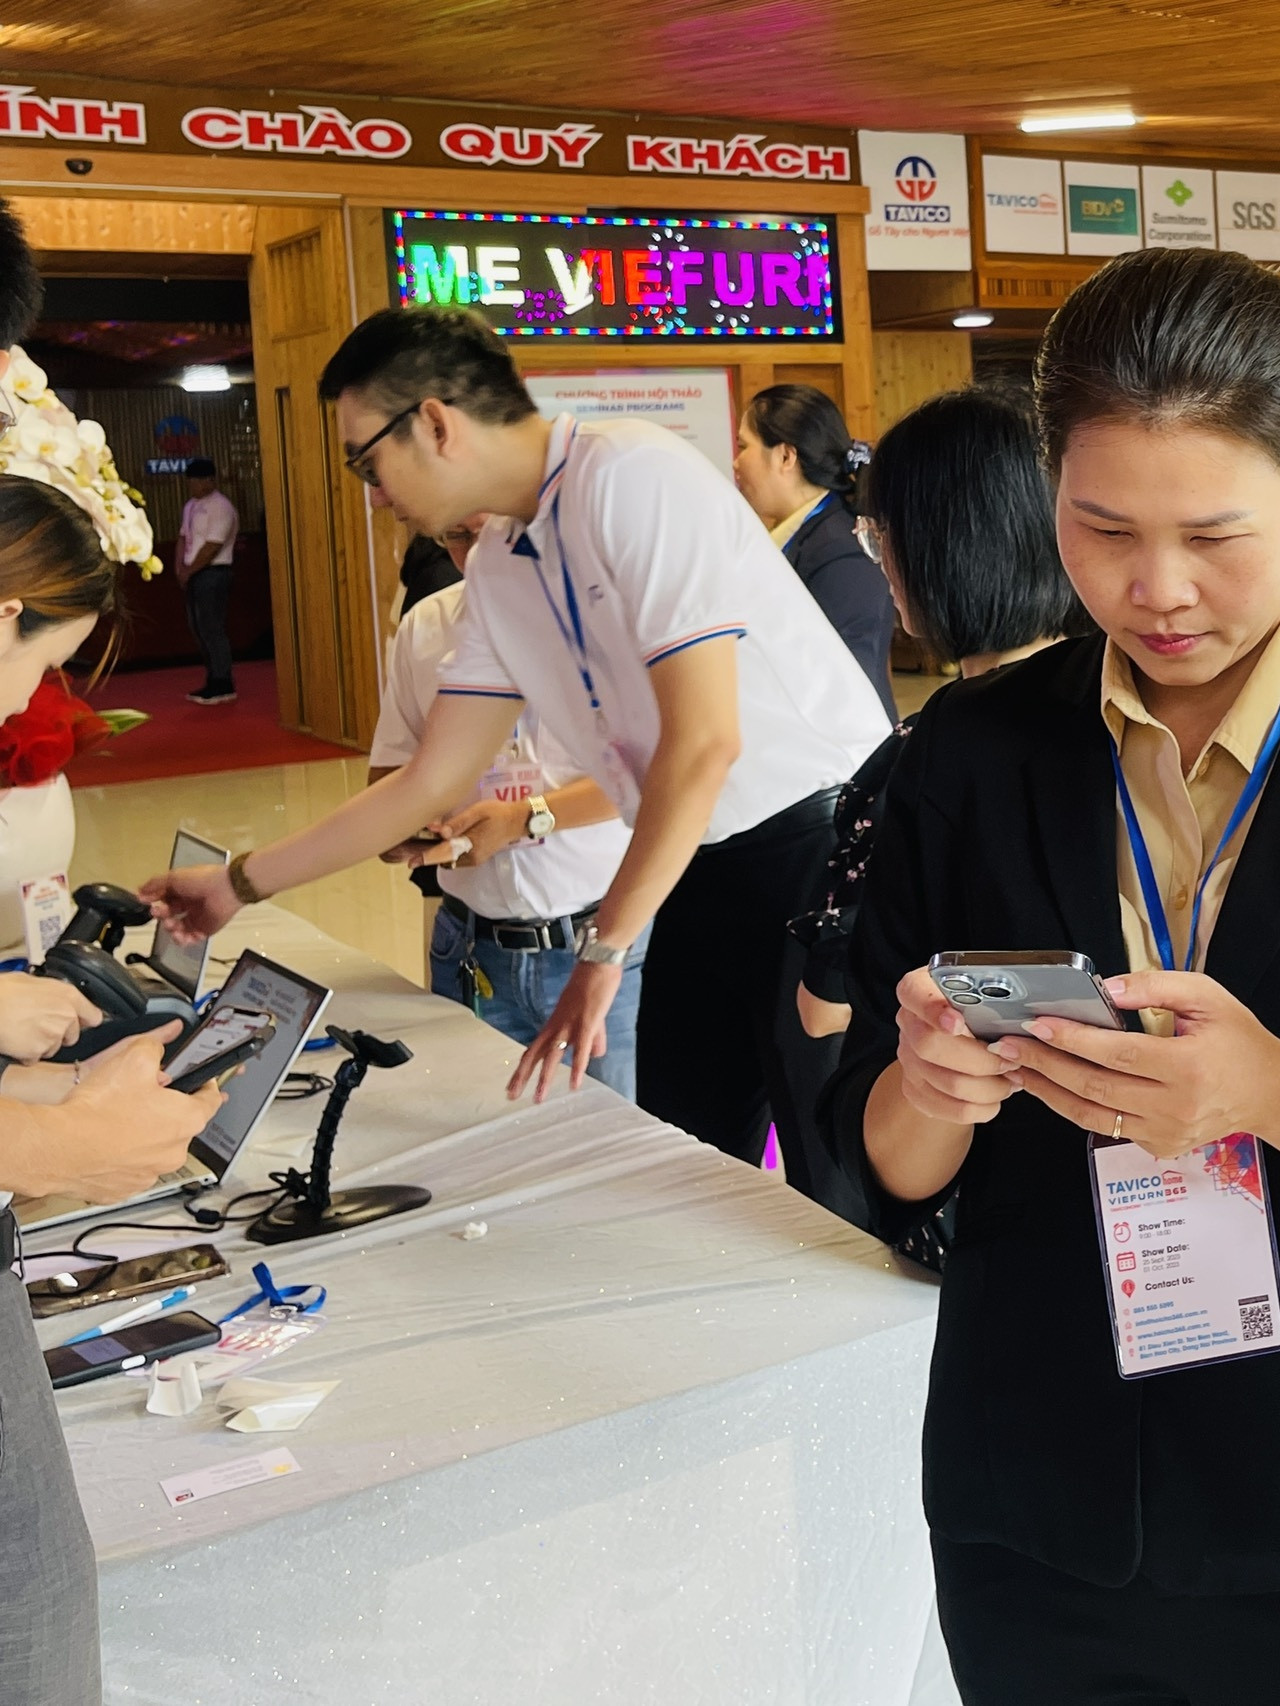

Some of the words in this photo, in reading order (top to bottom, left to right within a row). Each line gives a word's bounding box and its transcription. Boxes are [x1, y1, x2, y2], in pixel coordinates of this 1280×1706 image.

[182, 105, 412, 159] CHÀO
[440, 123, 602, 167] QUÝ
[627, 134, 851, 180] KHÁCH
[987, 193, 1038, 208] TAVICO
[886, 206, 949, 222] TAVICO
[1152, 212, 1208, 226] Sumitomo
[1232, 201, 1276, 230] SGS
[1149, 228, 1212, 242] Corporation
[411, 244, 525, 305] ME
[627, 402, 685, 411] PROGRAMS
[495, 785, 532, 802] VIP
[1106, 1175, 1161, 1195] TAVICO
[1108, 1186, 1188, 1206] VIEFURN365
[1138, 1223, 1161, 1232] Show
[1163, 1218, 1186, 1228] Time:
[1141, 1249, 1164, 1258] Show
[1166, 1243, 1191, 1253] Date:
[1145, 1278, 1179, 1291] Contact
[1182, 1276, 1195, 1285] Us:
